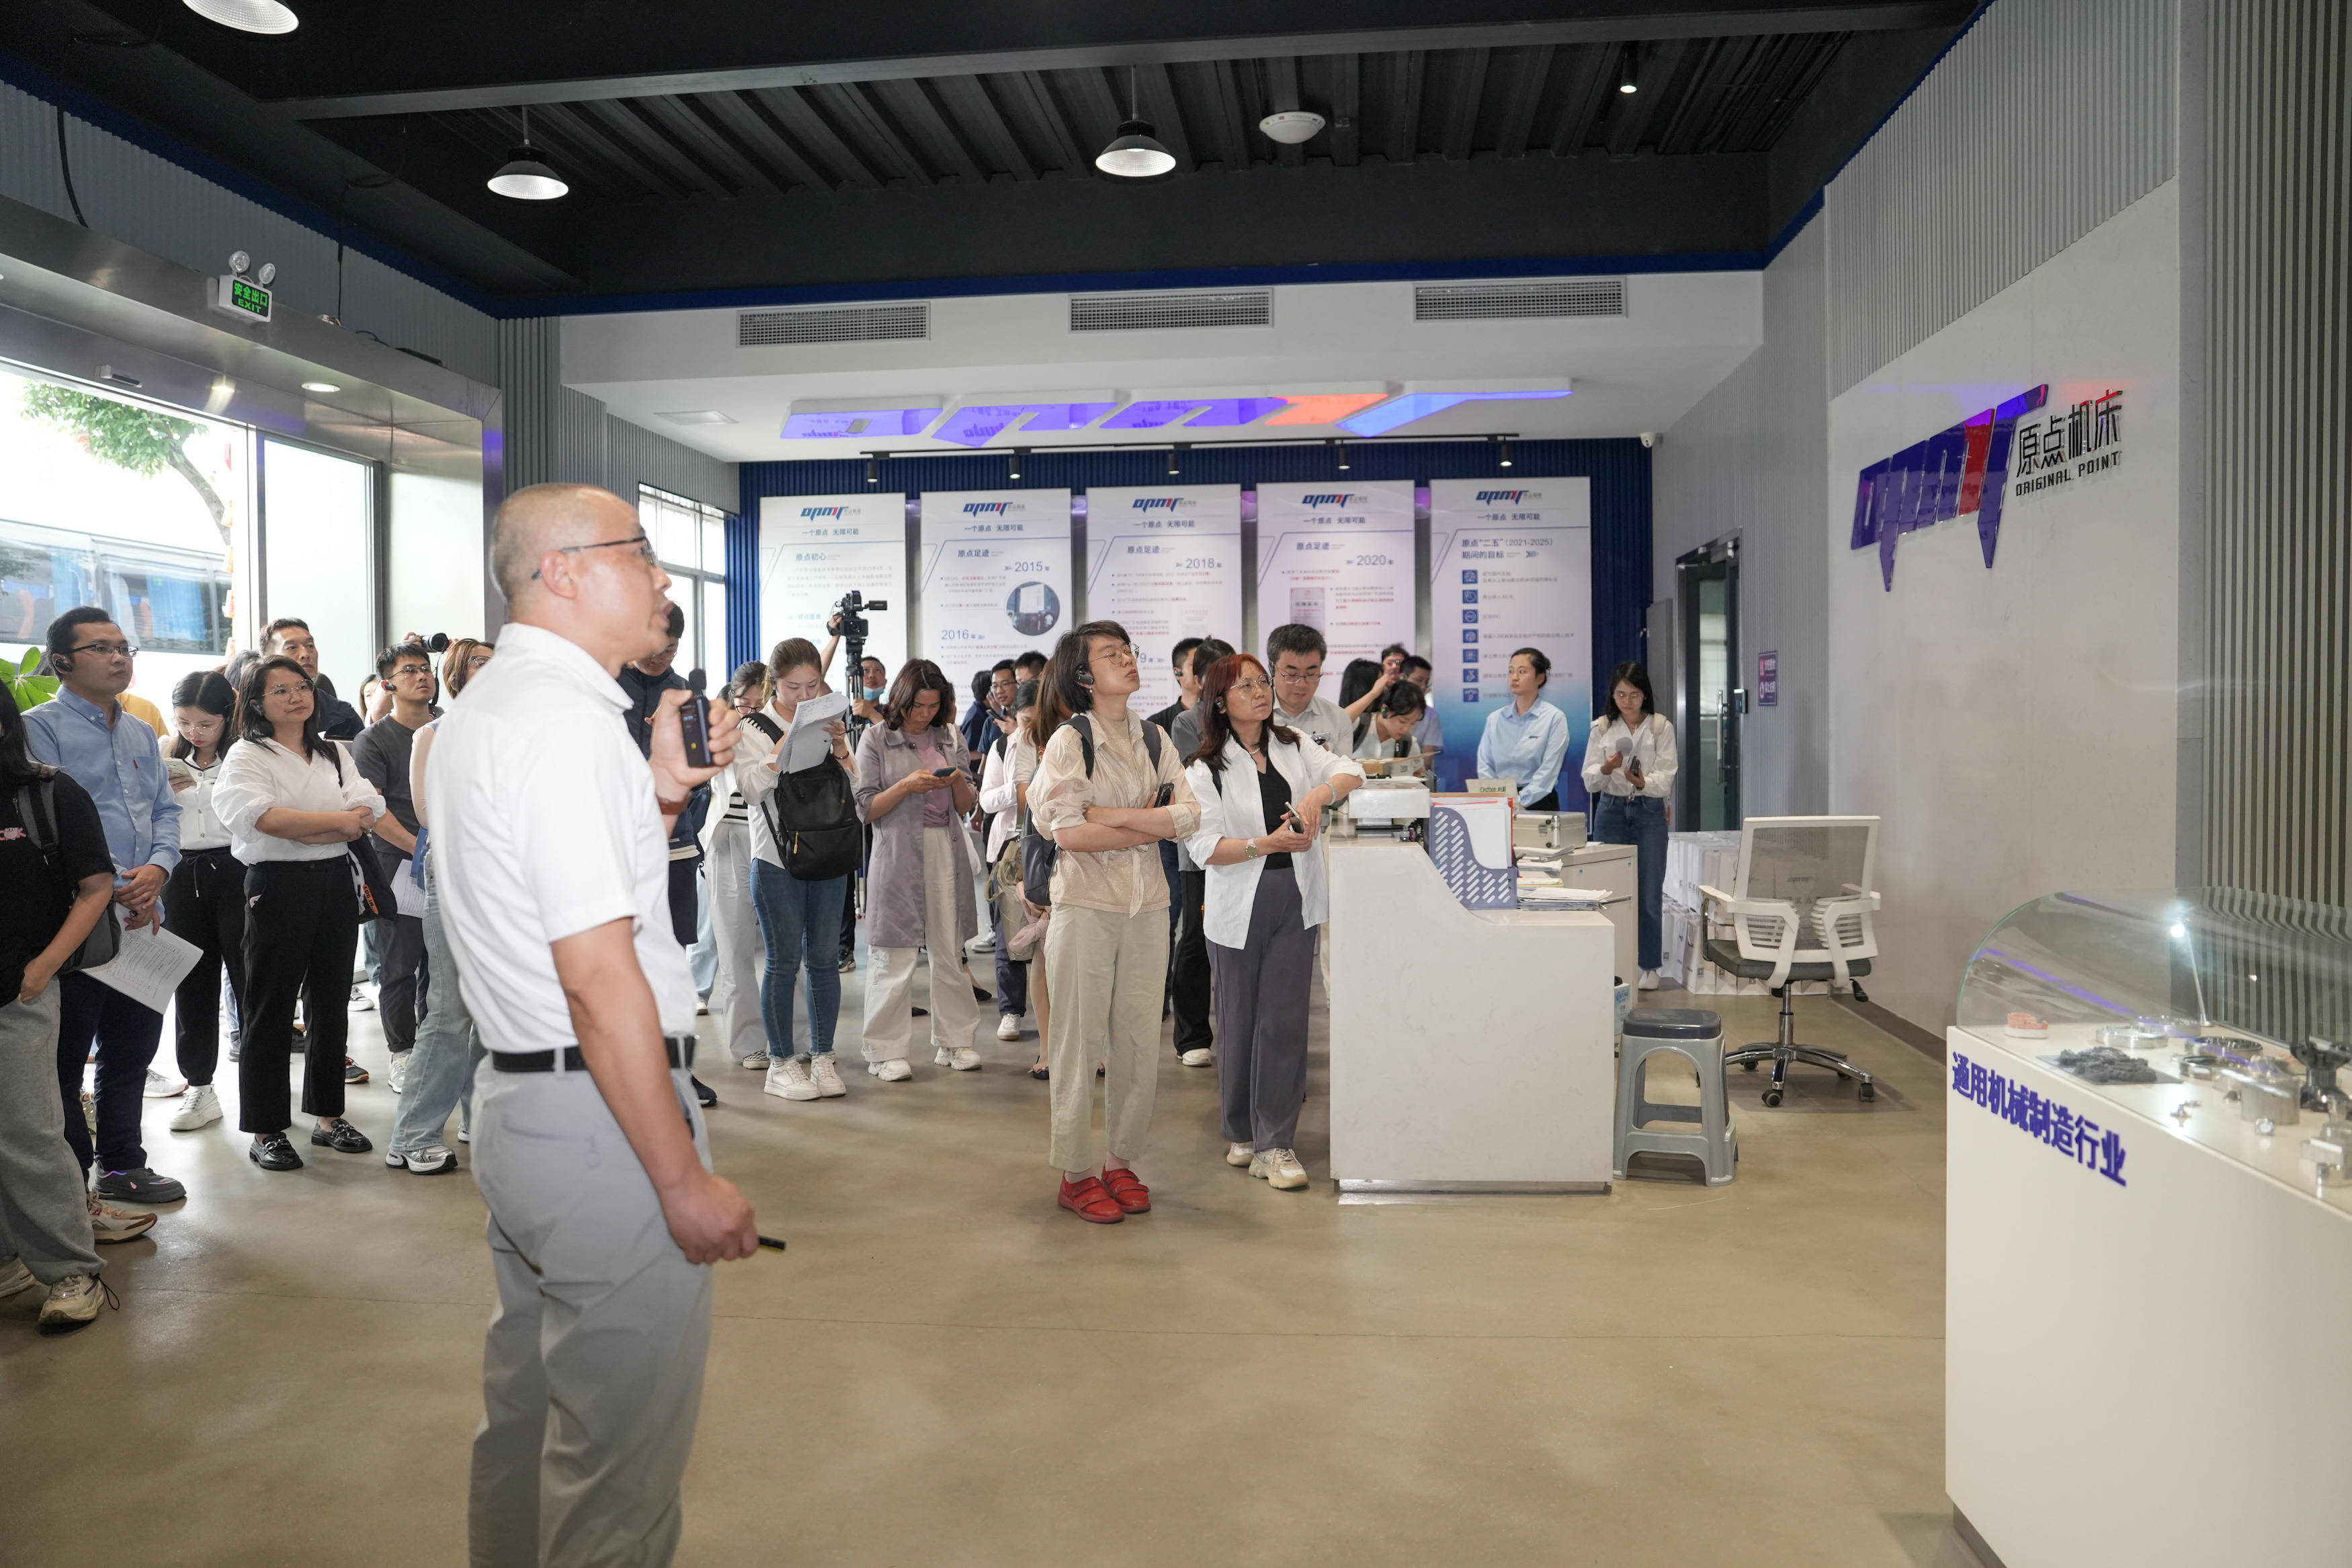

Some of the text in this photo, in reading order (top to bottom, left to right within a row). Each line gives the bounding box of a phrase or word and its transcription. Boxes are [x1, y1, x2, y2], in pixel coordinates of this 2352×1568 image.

[235, 283, 267, 306] 安全出口
[238, 298, 261, 313] EXIT
[2016, 389, 2124, 478] 原点机床
[2016, 451, 2121, 496] ORIGINAL POINT
[1511, 513, 1541, 521] 无限可能
[1134, 520, 1195, 529] 一个原点 无限可能
[802, 528, 859, 537] 一个原点 无限可能
[1127, 546, 1161, 554] 原点足迹
[1296, 542, 1330, 550] 原点足迹
[796, 553, 827, 562] 原点初心
[958, 549, 990, 558] 原点足迹
[1462, 551, 1504, 559] 期间的目标
[1952, 1051, 2127, 1187] 通用机械制造行业
